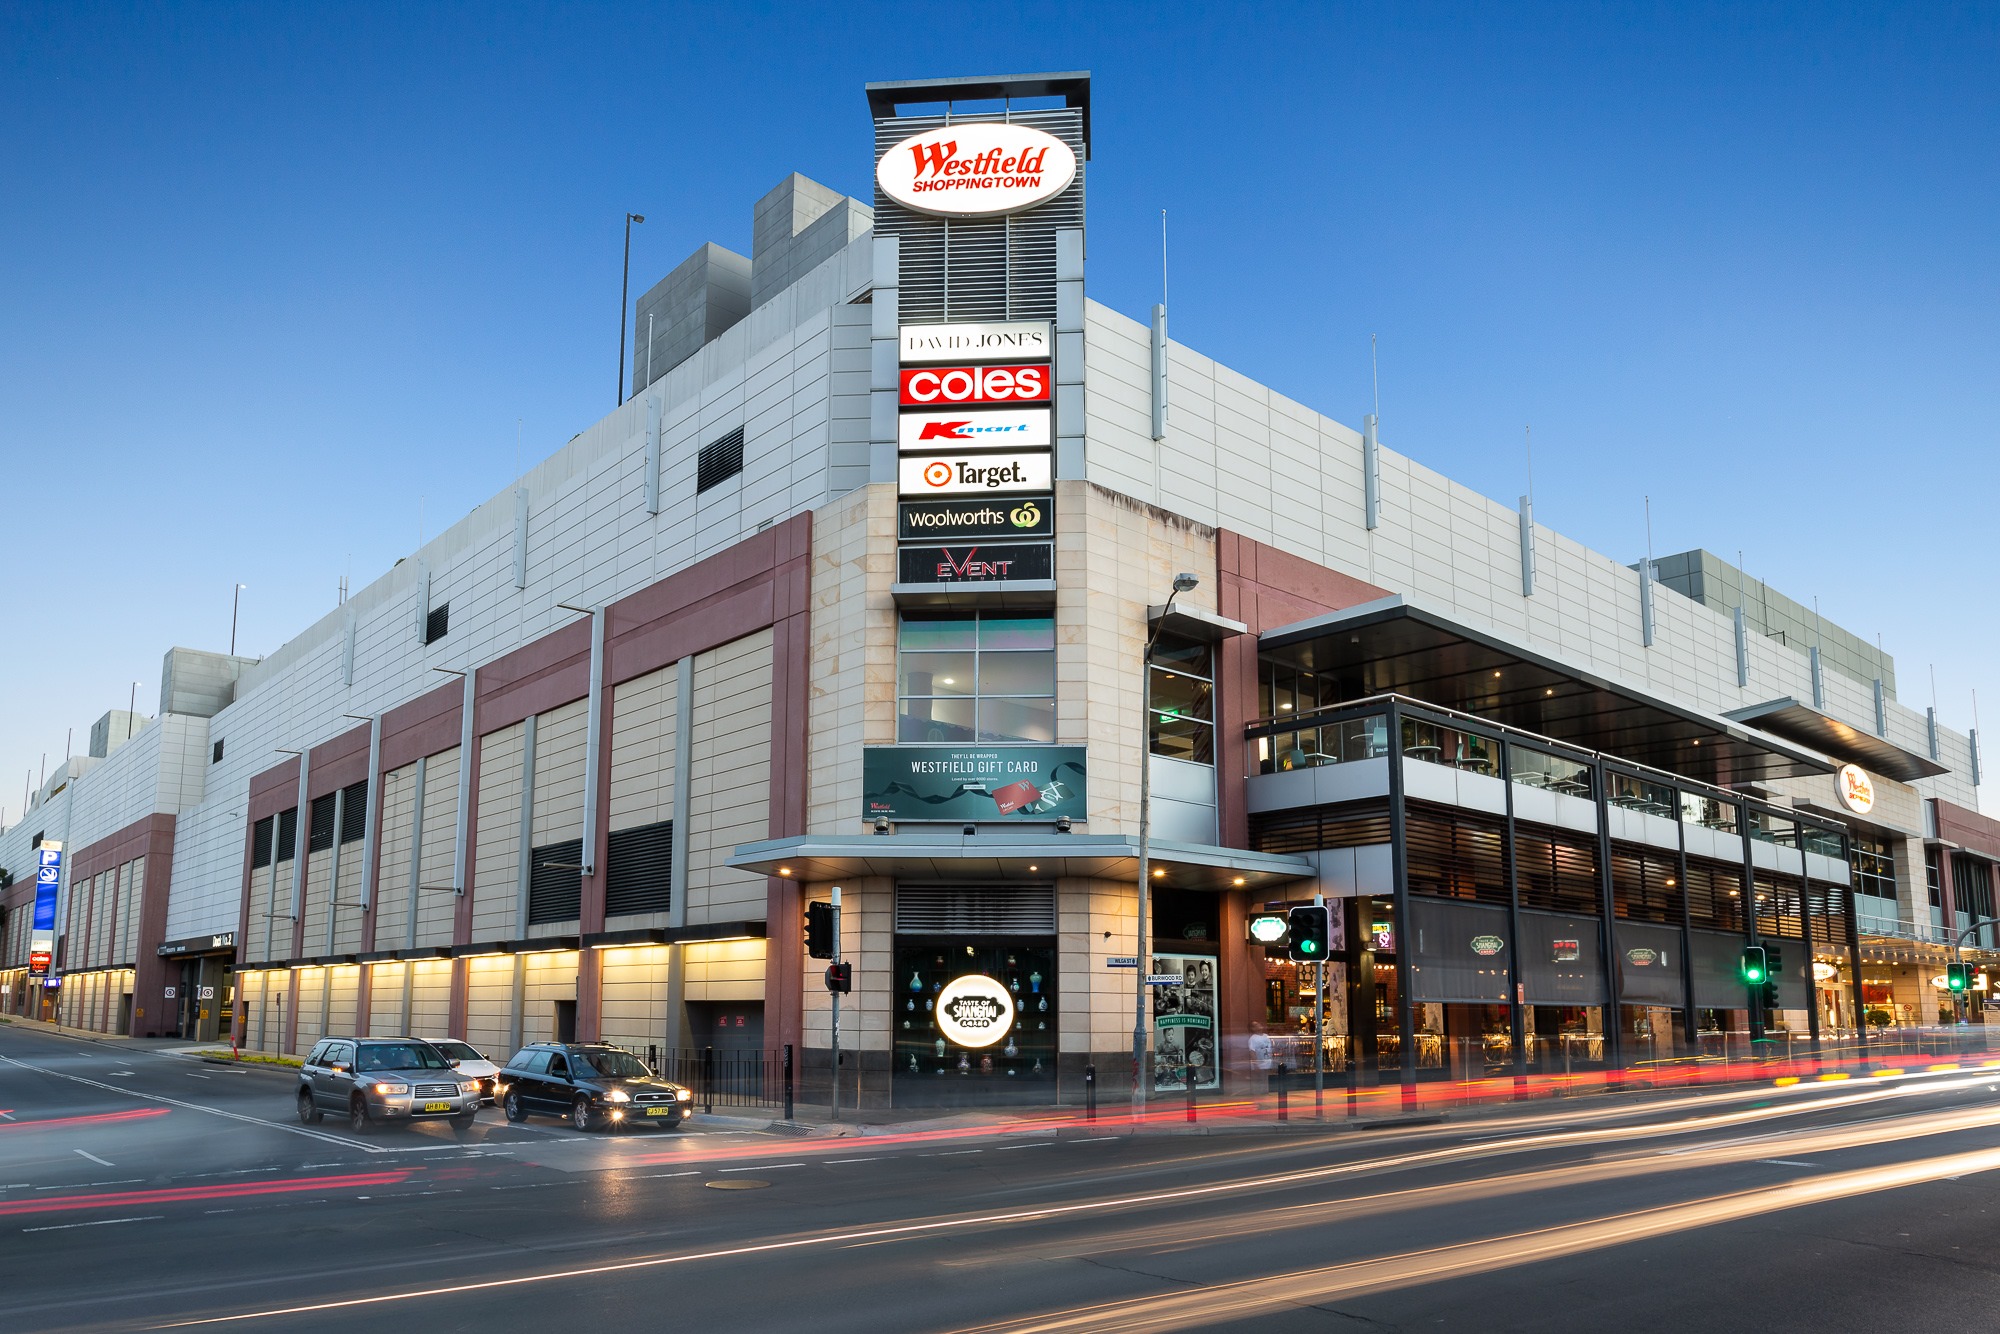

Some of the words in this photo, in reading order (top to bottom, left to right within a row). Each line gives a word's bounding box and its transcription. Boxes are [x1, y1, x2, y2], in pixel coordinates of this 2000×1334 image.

[908, 140, 1050, 180] Westfield
[912, 176, 1041, 193] SHOPPINGTOWN
[976, 331, 1043, 348] JONES
[908, 367, 1042, 402] coles
[918, 421, 1031, 440] Kmart
[911, 761, 974, 773] WESTFIELD
[978, 761, 1003, 773] GIFT
[1007, 761, 1038, 773] CARD
[42, 851, 58, 865] P
[953, 1005, 997, 1018] SHANGHAI
